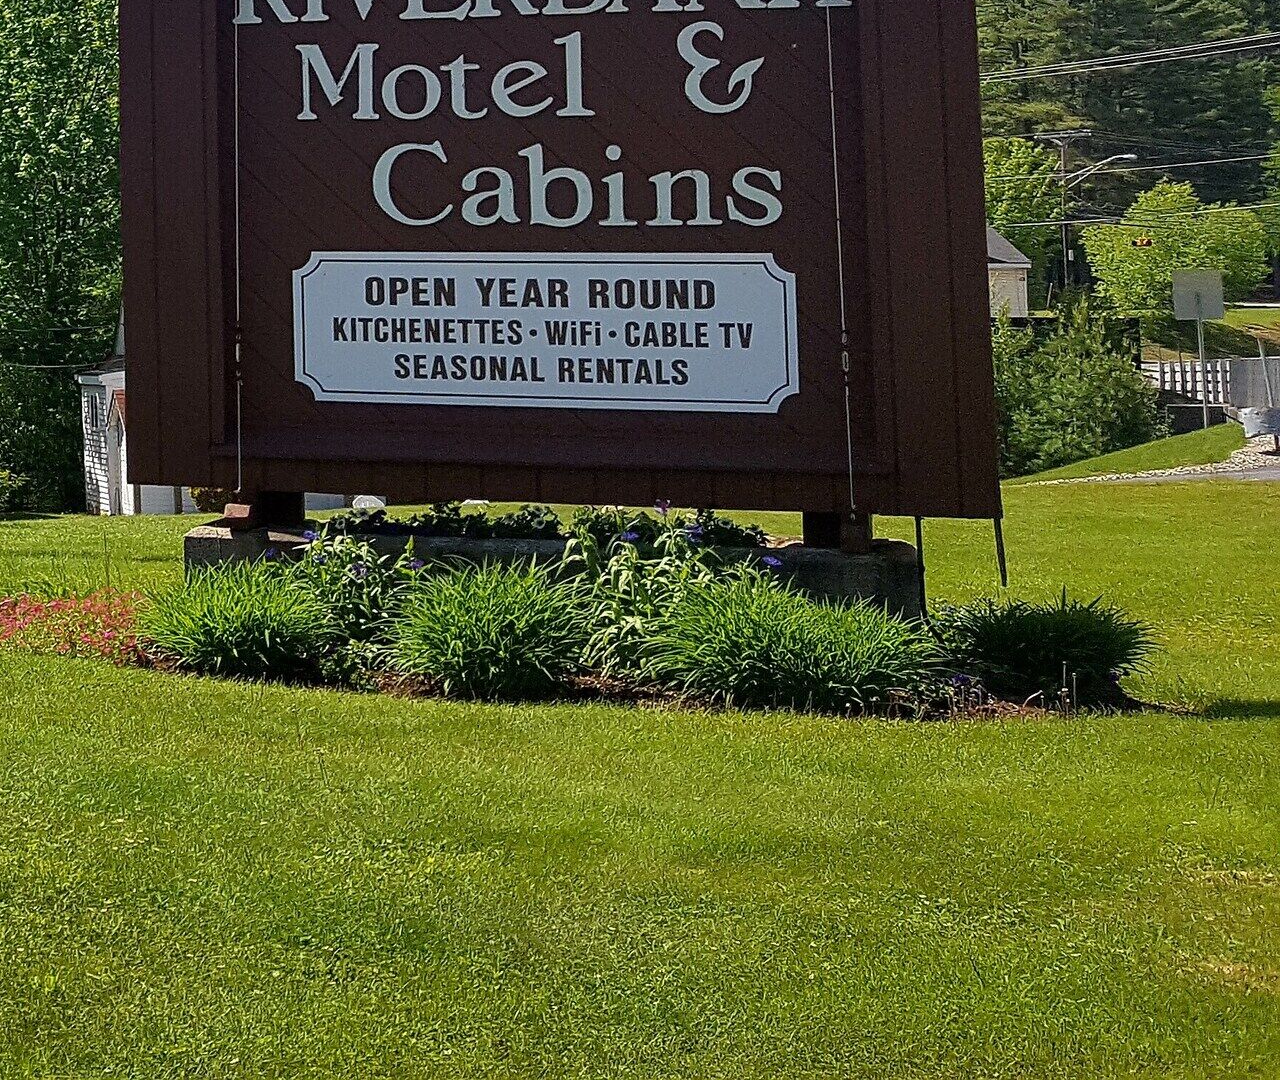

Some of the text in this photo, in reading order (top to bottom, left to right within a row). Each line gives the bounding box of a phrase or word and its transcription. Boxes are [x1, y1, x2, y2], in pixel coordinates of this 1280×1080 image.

[296, 22, 764, 119] Motel &
[373, 141, 782, 227] Cabins
[365, 277, 715, 309] OPEN YEAR ROUND
[333, 317, 754, 349] KITCHENETTES WiFi CABLE TV
[394, 354, 688, 385] SEASONAL RENTALS
